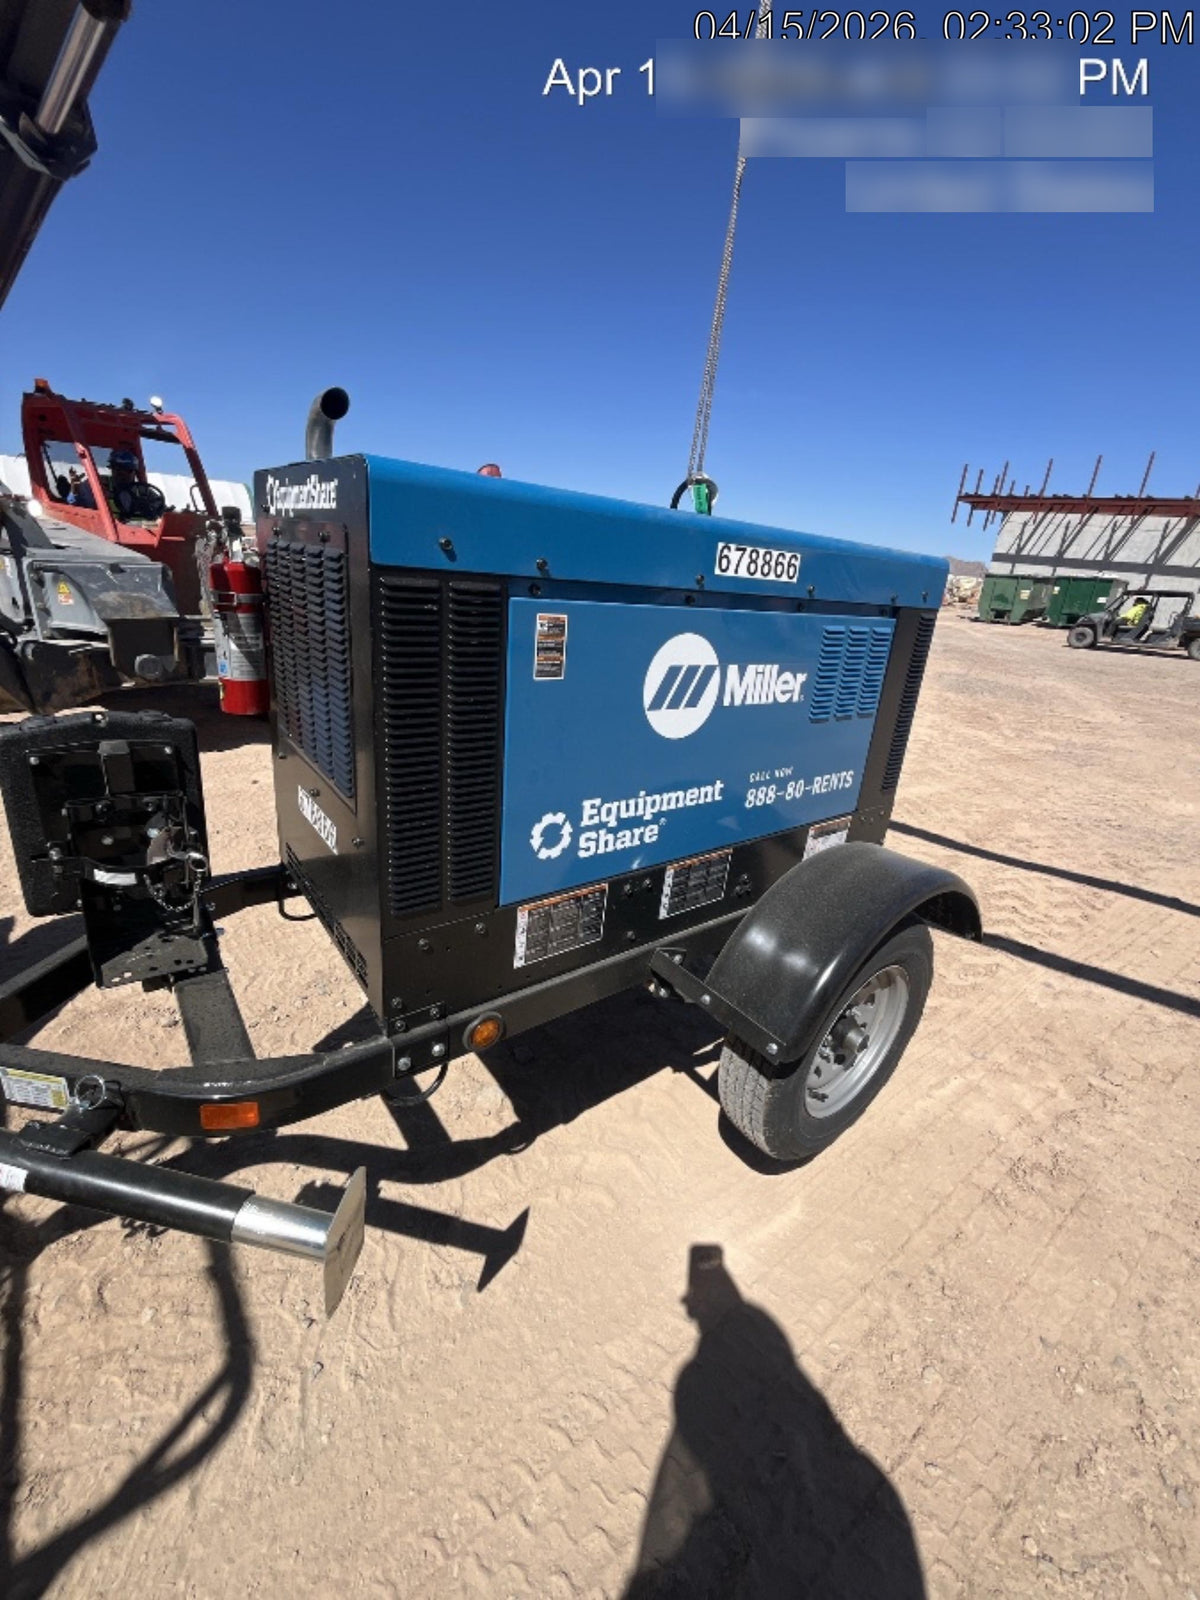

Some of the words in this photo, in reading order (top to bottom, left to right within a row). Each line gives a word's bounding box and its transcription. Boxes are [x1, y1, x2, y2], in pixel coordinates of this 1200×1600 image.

[717, 544, 799, 580] 678866
[723, 664, 807, 706] Miller
[580, 780, 725, 828] Equipment
[744, 769, 855, 808] 888-80-RENTS
